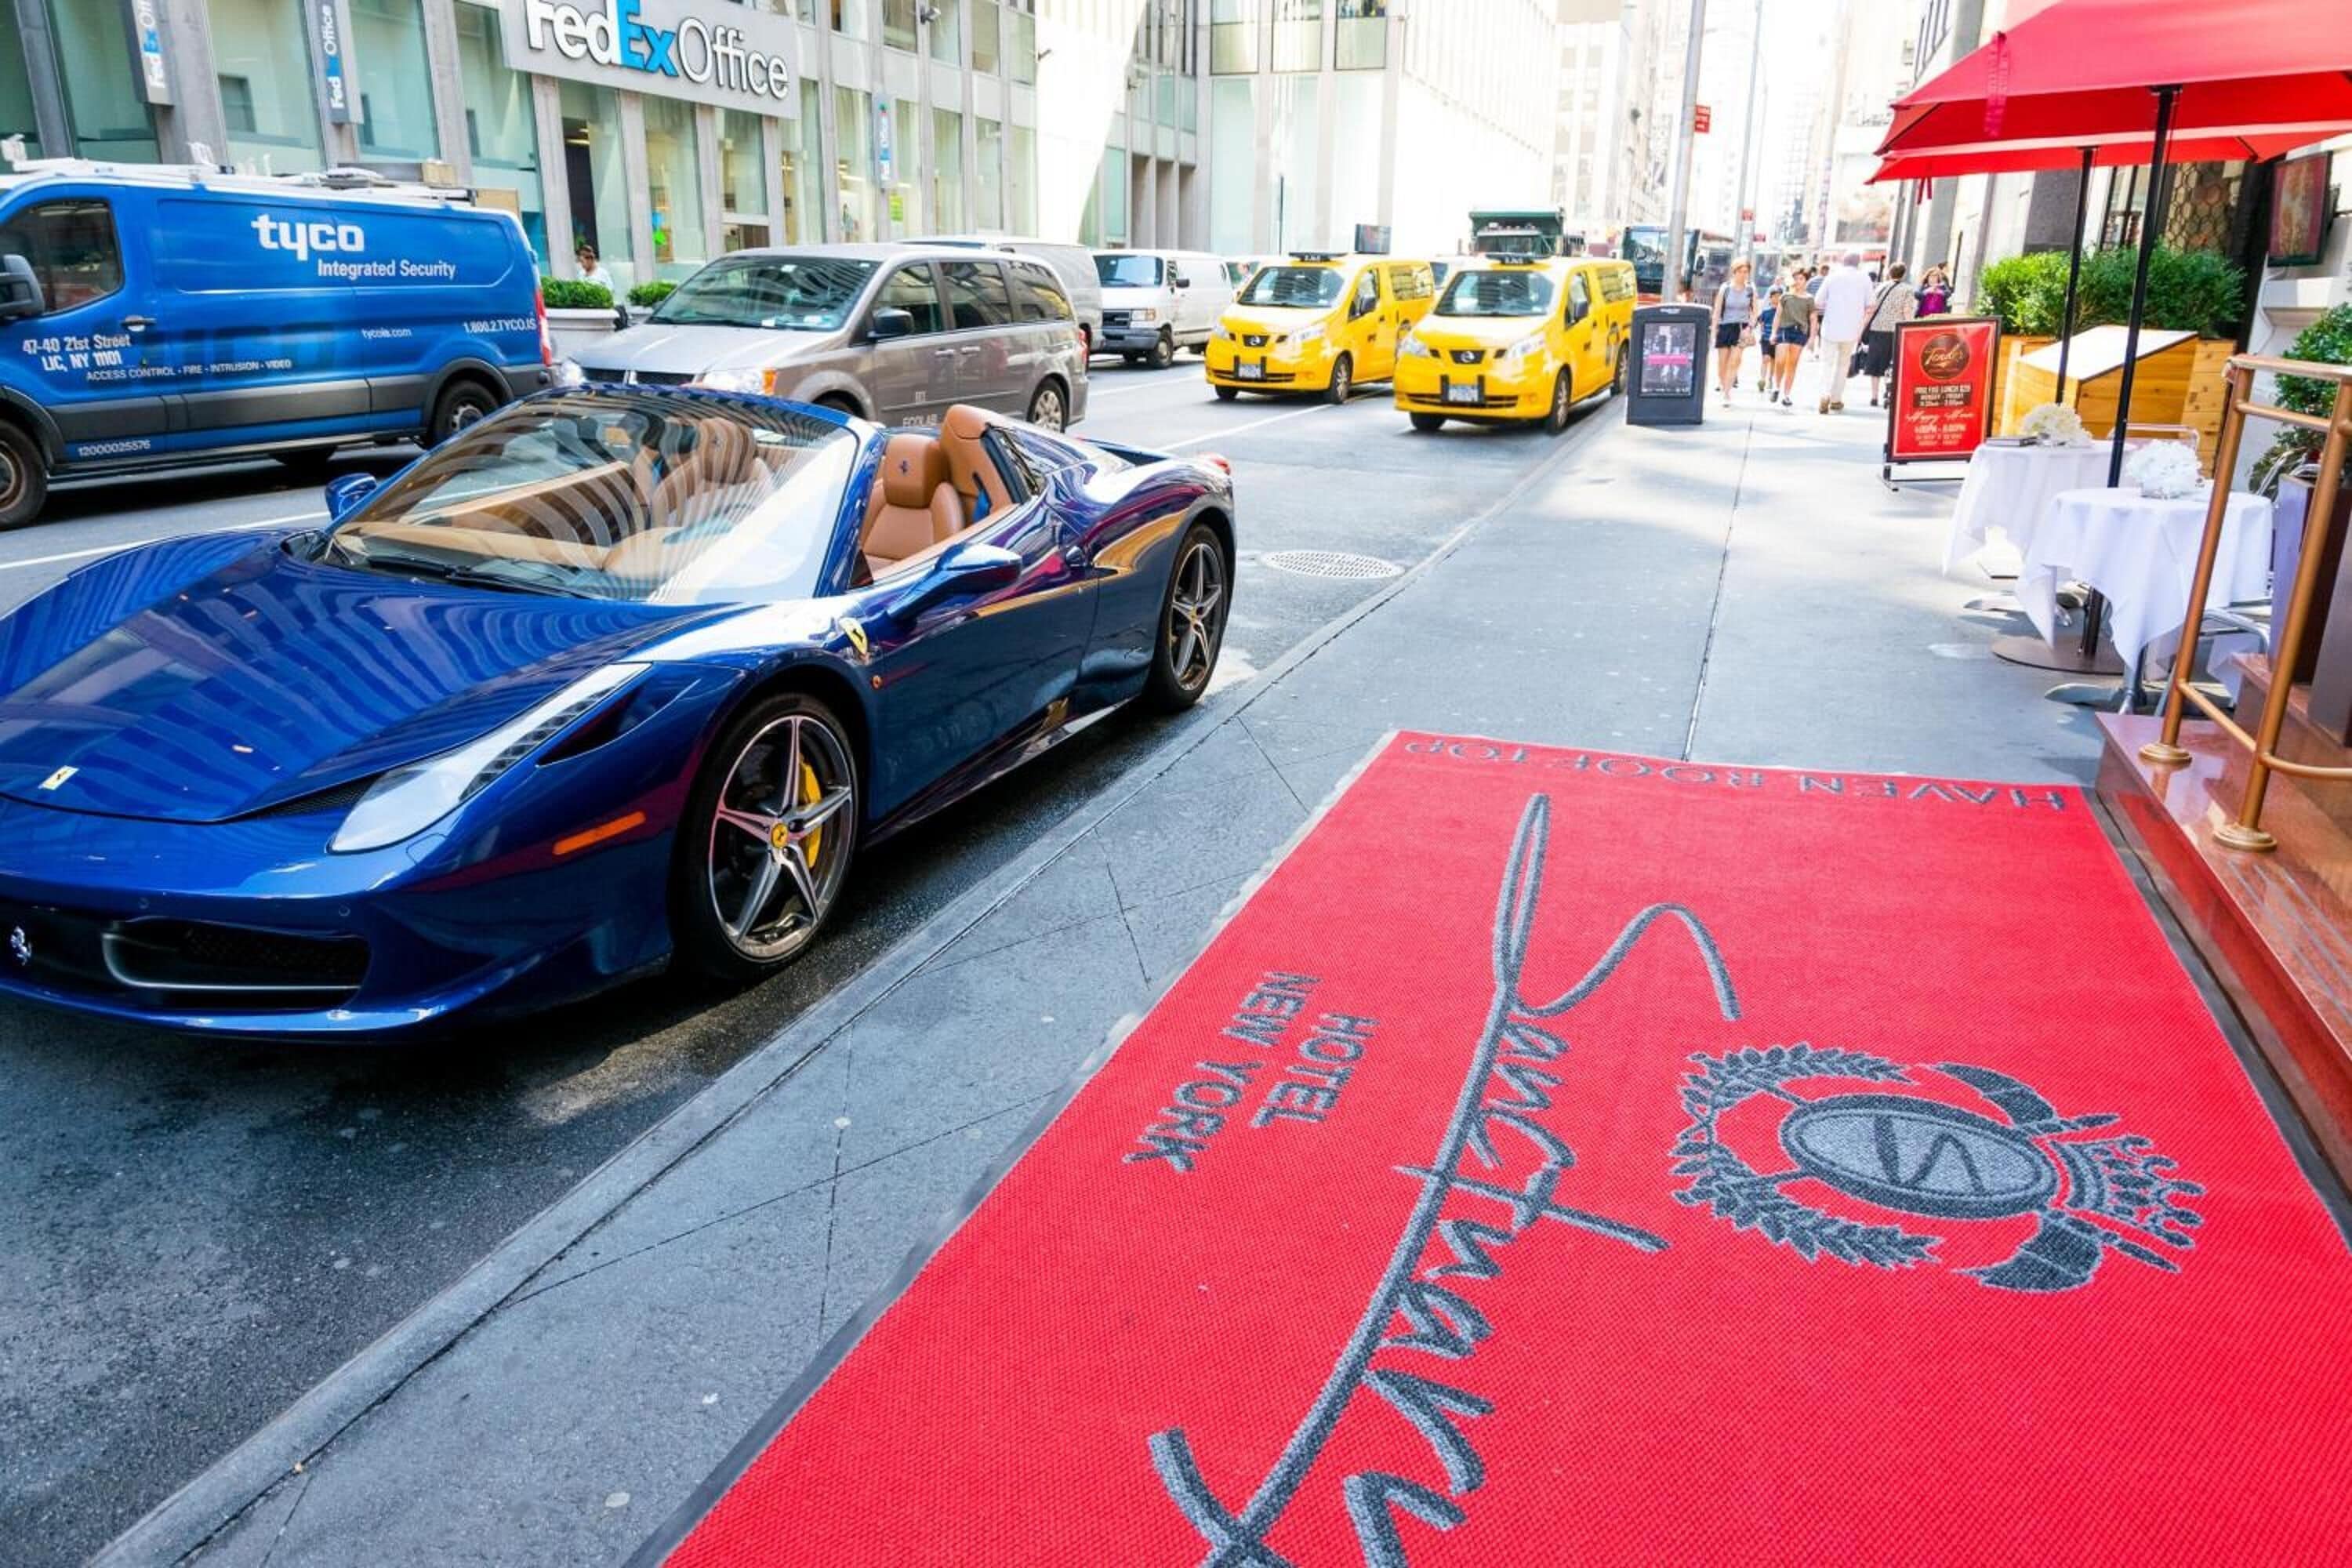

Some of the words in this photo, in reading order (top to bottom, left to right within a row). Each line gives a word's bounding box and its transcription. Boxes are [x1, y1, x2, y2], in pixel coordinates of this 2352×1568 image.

[321, 5, 337, 55] Office
[526, 0, 678, 77] FedEx
[677, 16, 789, 99] Office
[143, 27, 167, 88] FedEx
[325, 54, 345, 109] FedEx
[251, 214, 365, 261] tyco
[318, 259, 395, 280] Integrated
[400, 260, 456, 280] Security
[23, 338, 60, 354] 47-40
[64, 336, 90, 351] 21st
[93, 334, 131, 349] Street
[69, 353, 89, 368] NY
[92, 350, 123, 366] 11101
[87, 369, 126, 381] ACCESS
[129, 366, 176, 378] CONTROL
[183, 365, 203, 375] FIRE
[209, 361, 260, 372] INTRUSION
[265, 359, 292, 369] VIDEO
[1406, 739, 1762, 788] ROOFTOP
[1800, 775, 2066, 811] HAVEN
[1219, 971, 1323, 1047] NEW
[1250, 1012, 1381, 1129] HOTEL
[1121, 1060, 1265, 1172] YORK
